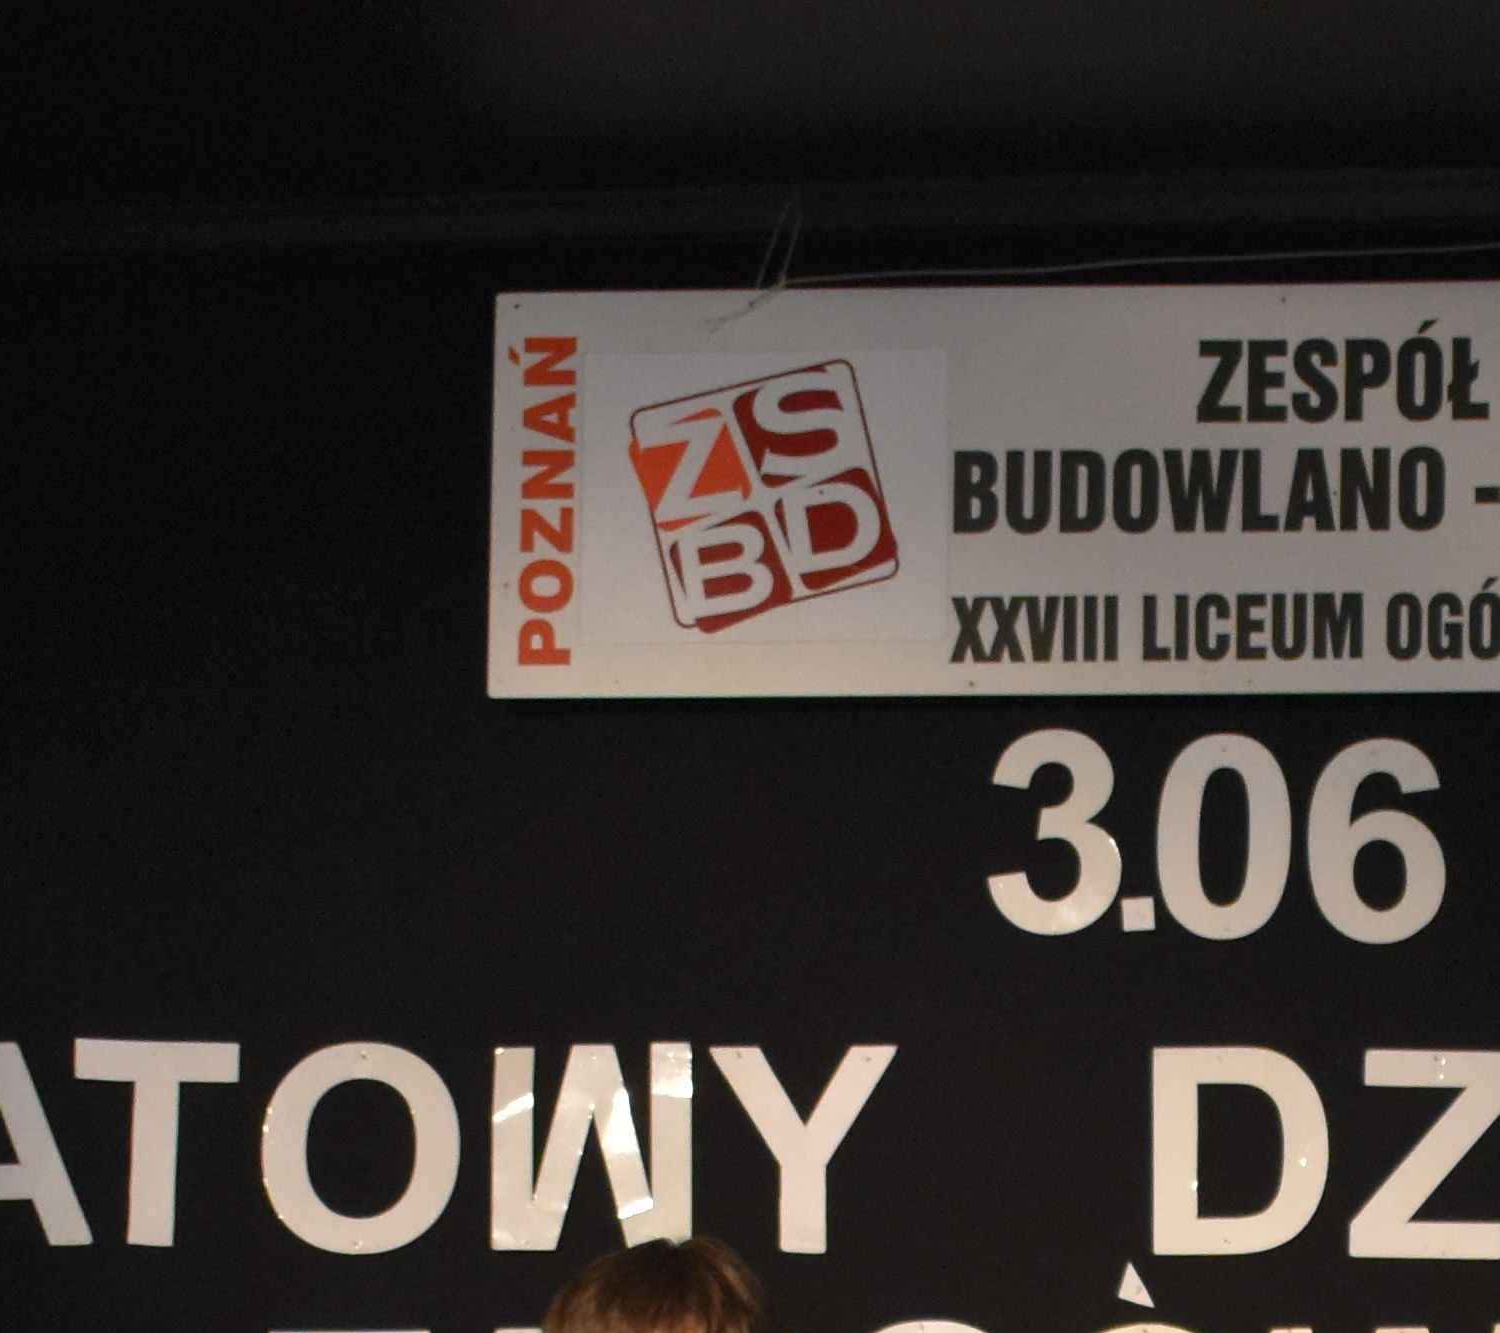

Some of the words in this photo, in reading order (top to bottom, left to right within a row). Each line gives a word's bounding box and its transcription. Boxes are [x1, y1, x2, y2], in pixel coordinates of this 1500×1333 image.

[1197, 318, 1490, 425] ZESPÓŁ
[509, 333, 579, 668] POZNAŃ
[950, 448, 1448, 537] BUDOWLANO
[949, 597, 1120, 666] XXVIII
[1143, 591, 1365, 664] LICEUM
[987, 727, 1449, 945] 3.06
